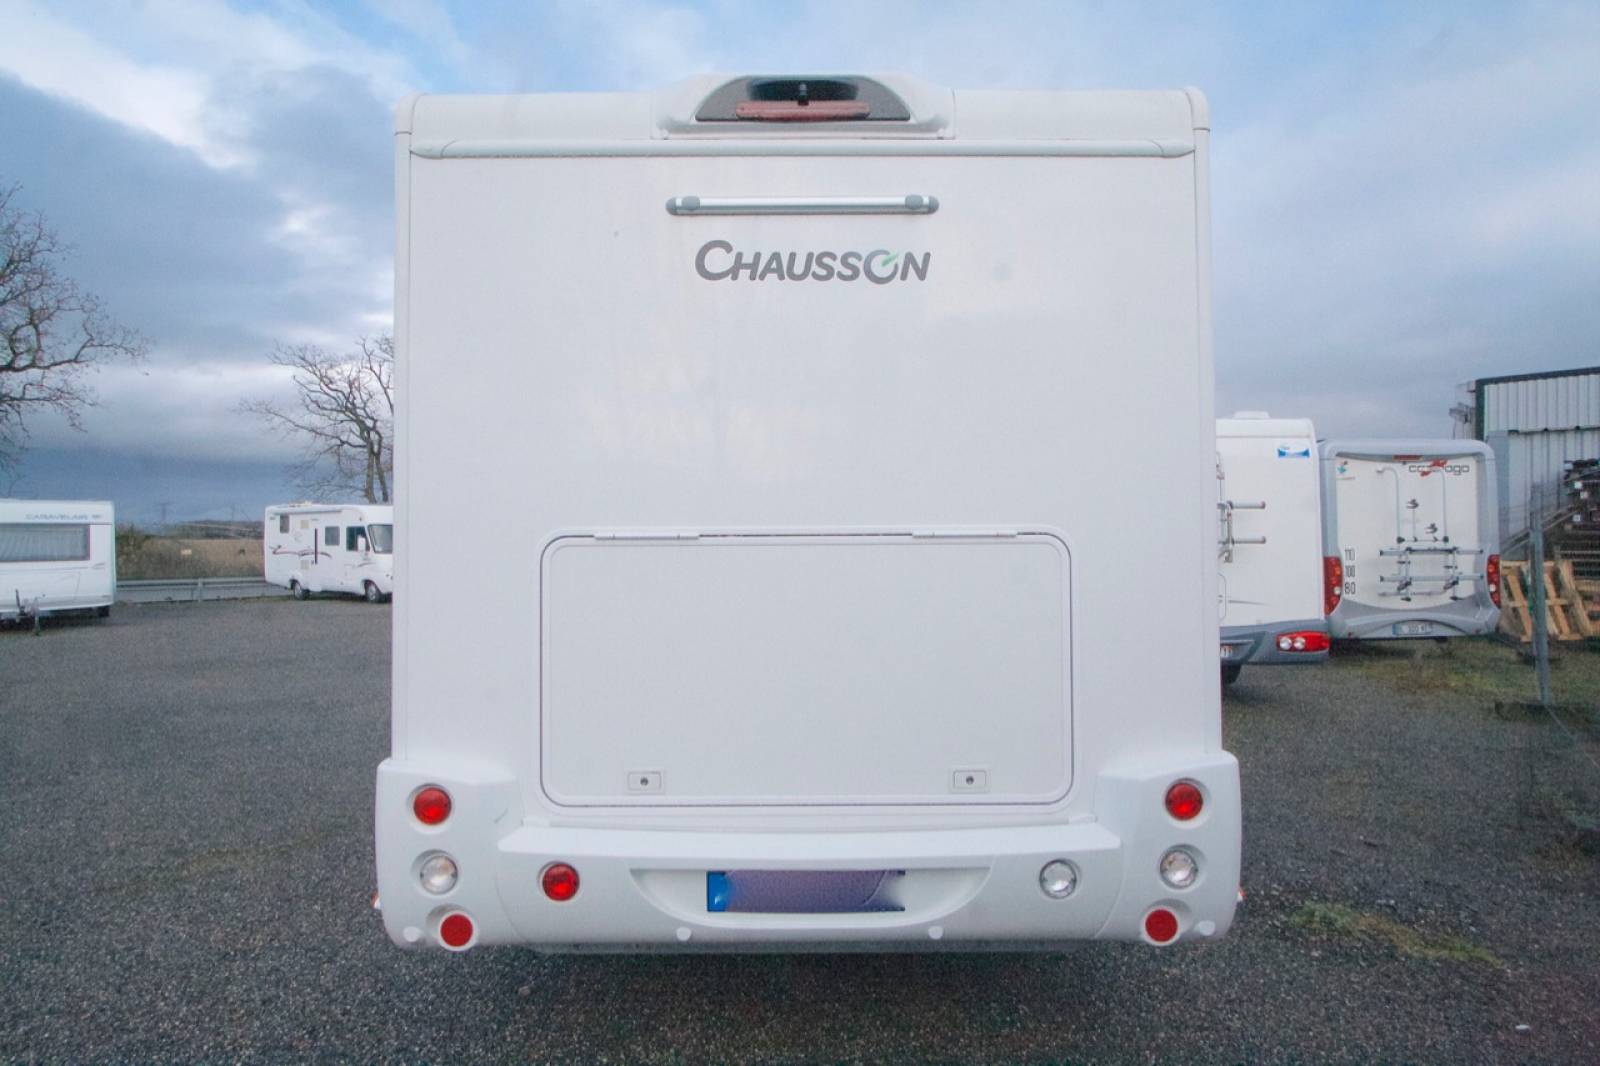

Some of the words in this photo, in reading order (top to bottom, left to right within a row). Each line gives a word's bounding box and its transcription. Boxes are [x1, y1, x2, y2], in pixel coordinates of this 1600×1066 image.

[695, 240, 931, 284] CHAUSSON
[1408, 463, 1470, 476] caago
[1344, 582, 1356, 595] 80
